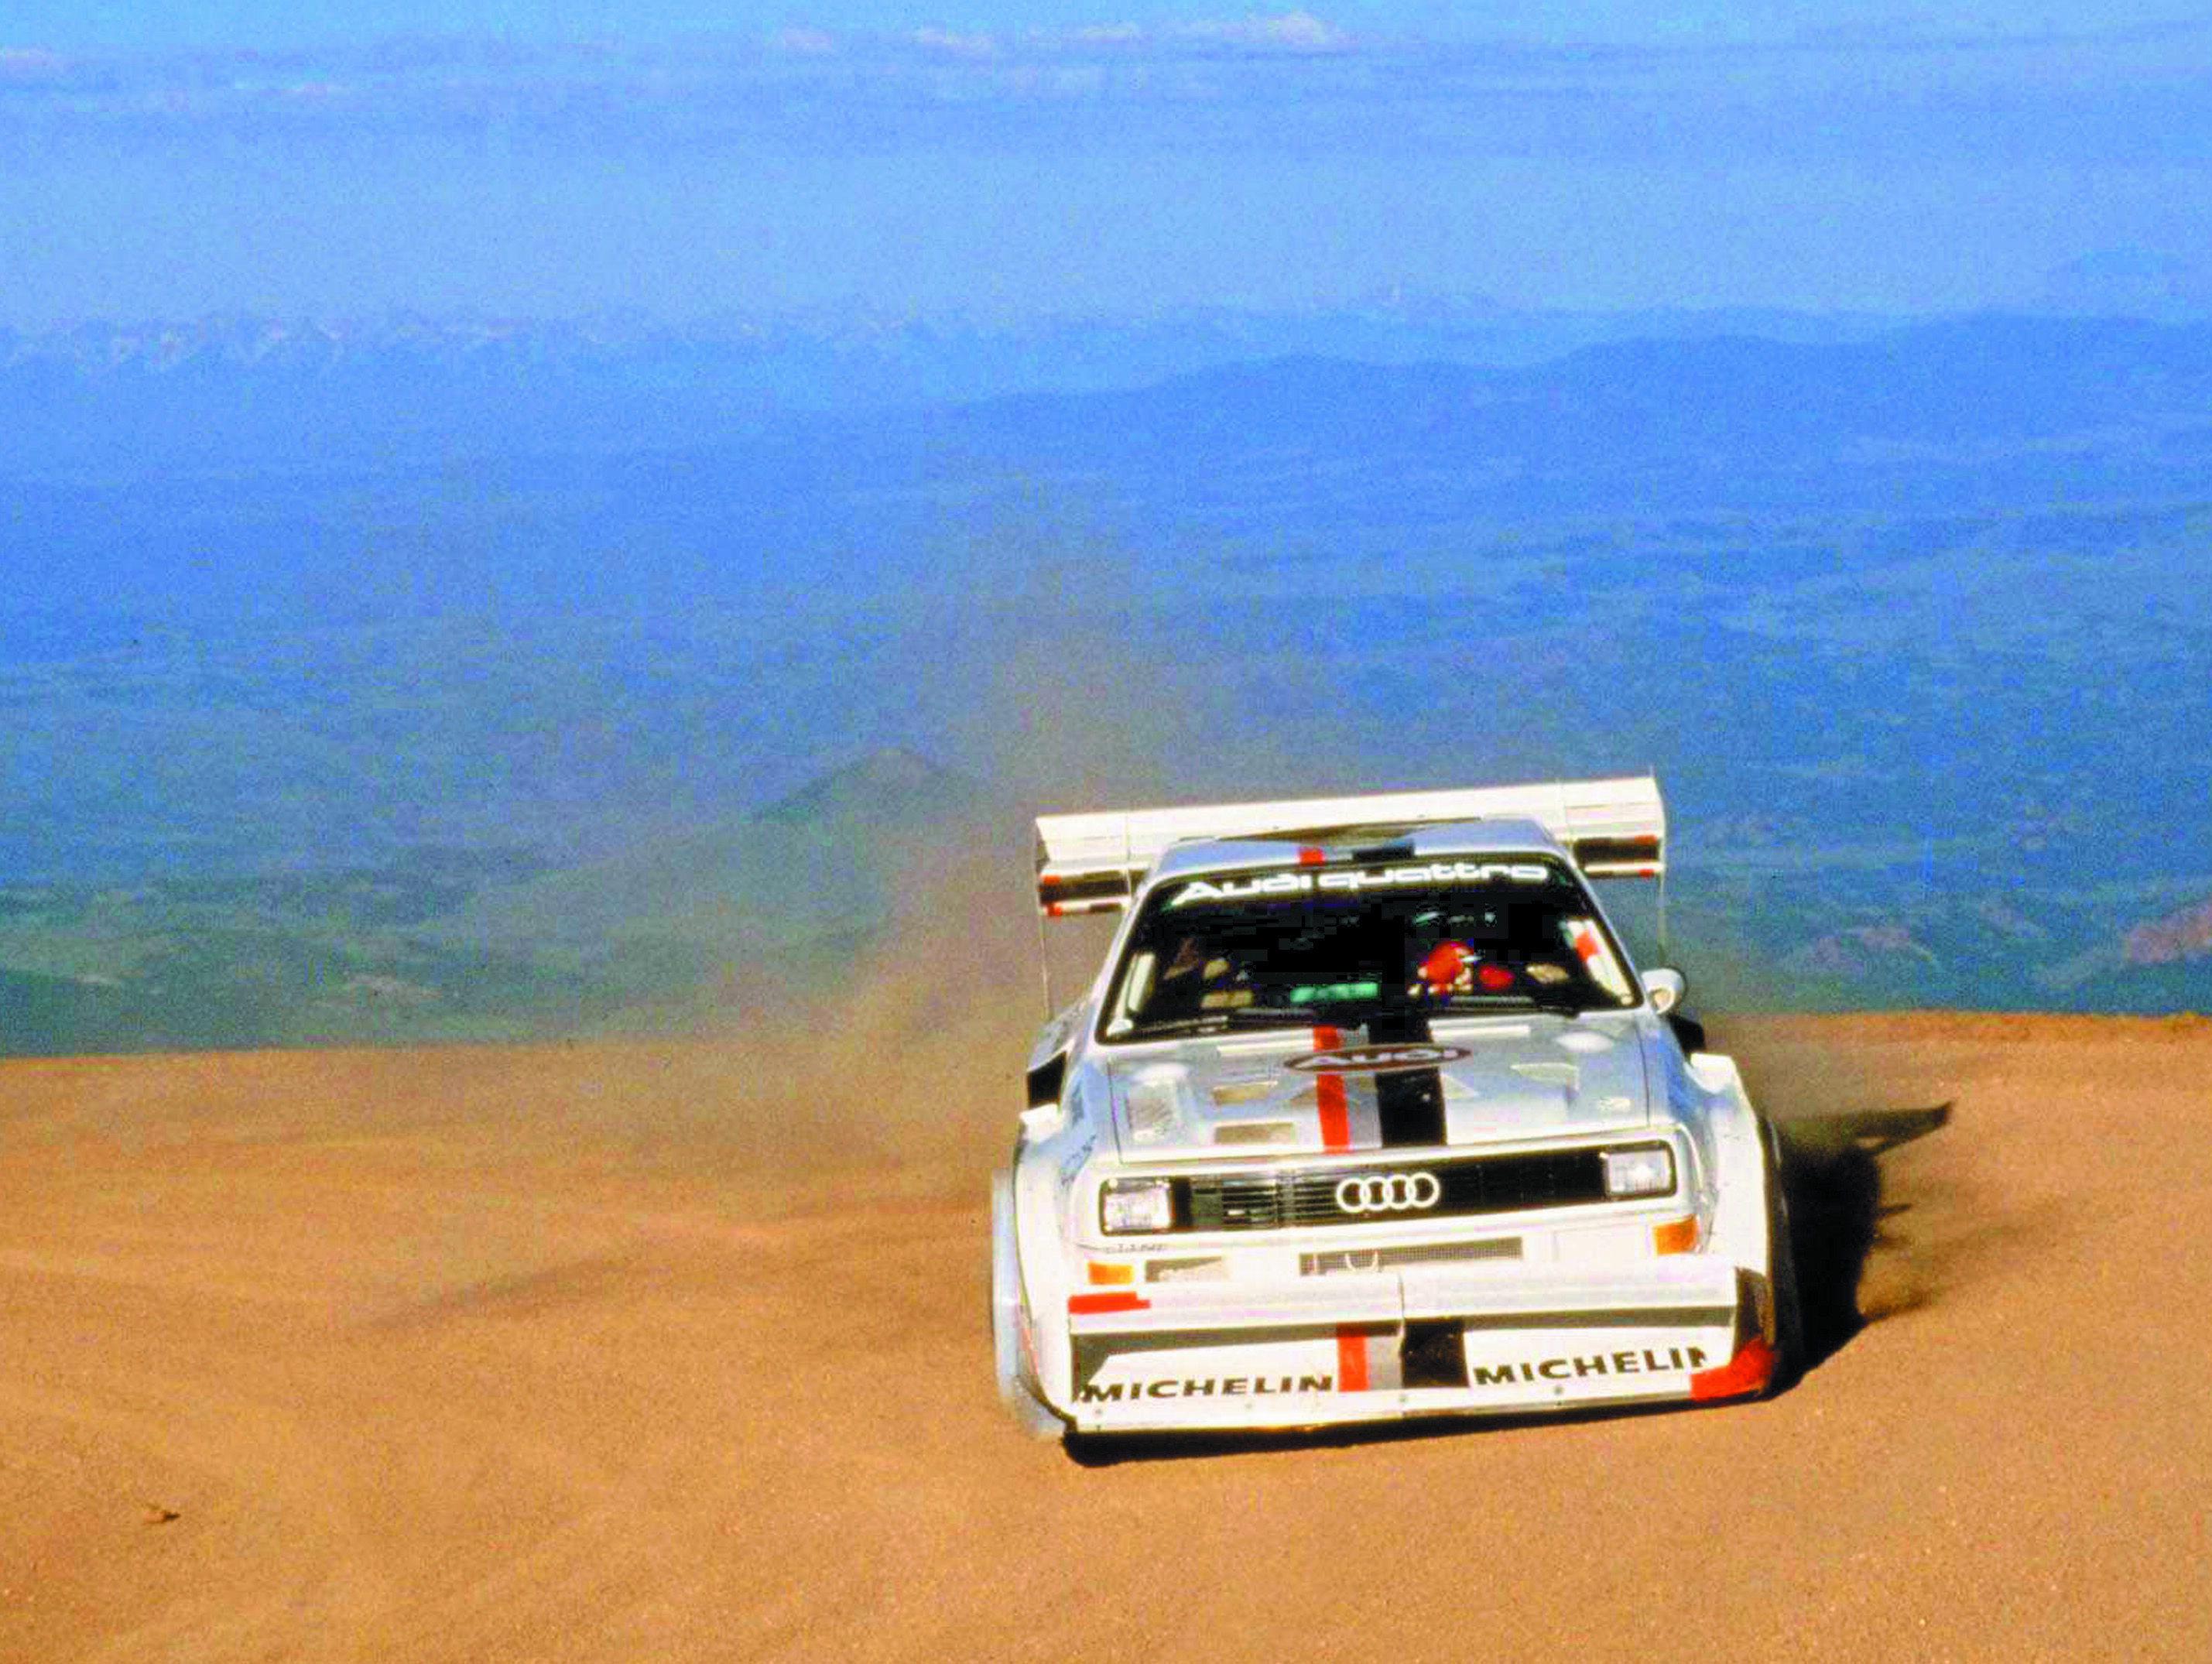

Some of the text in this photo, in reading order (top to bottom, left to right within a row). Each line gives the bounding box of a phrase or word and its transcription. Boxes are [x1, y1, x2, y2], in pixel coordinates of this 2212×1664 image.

[1170, 862, 1549, 906] Audi quattro
[1083, 1375, 1333, 1404] MICHELIN
